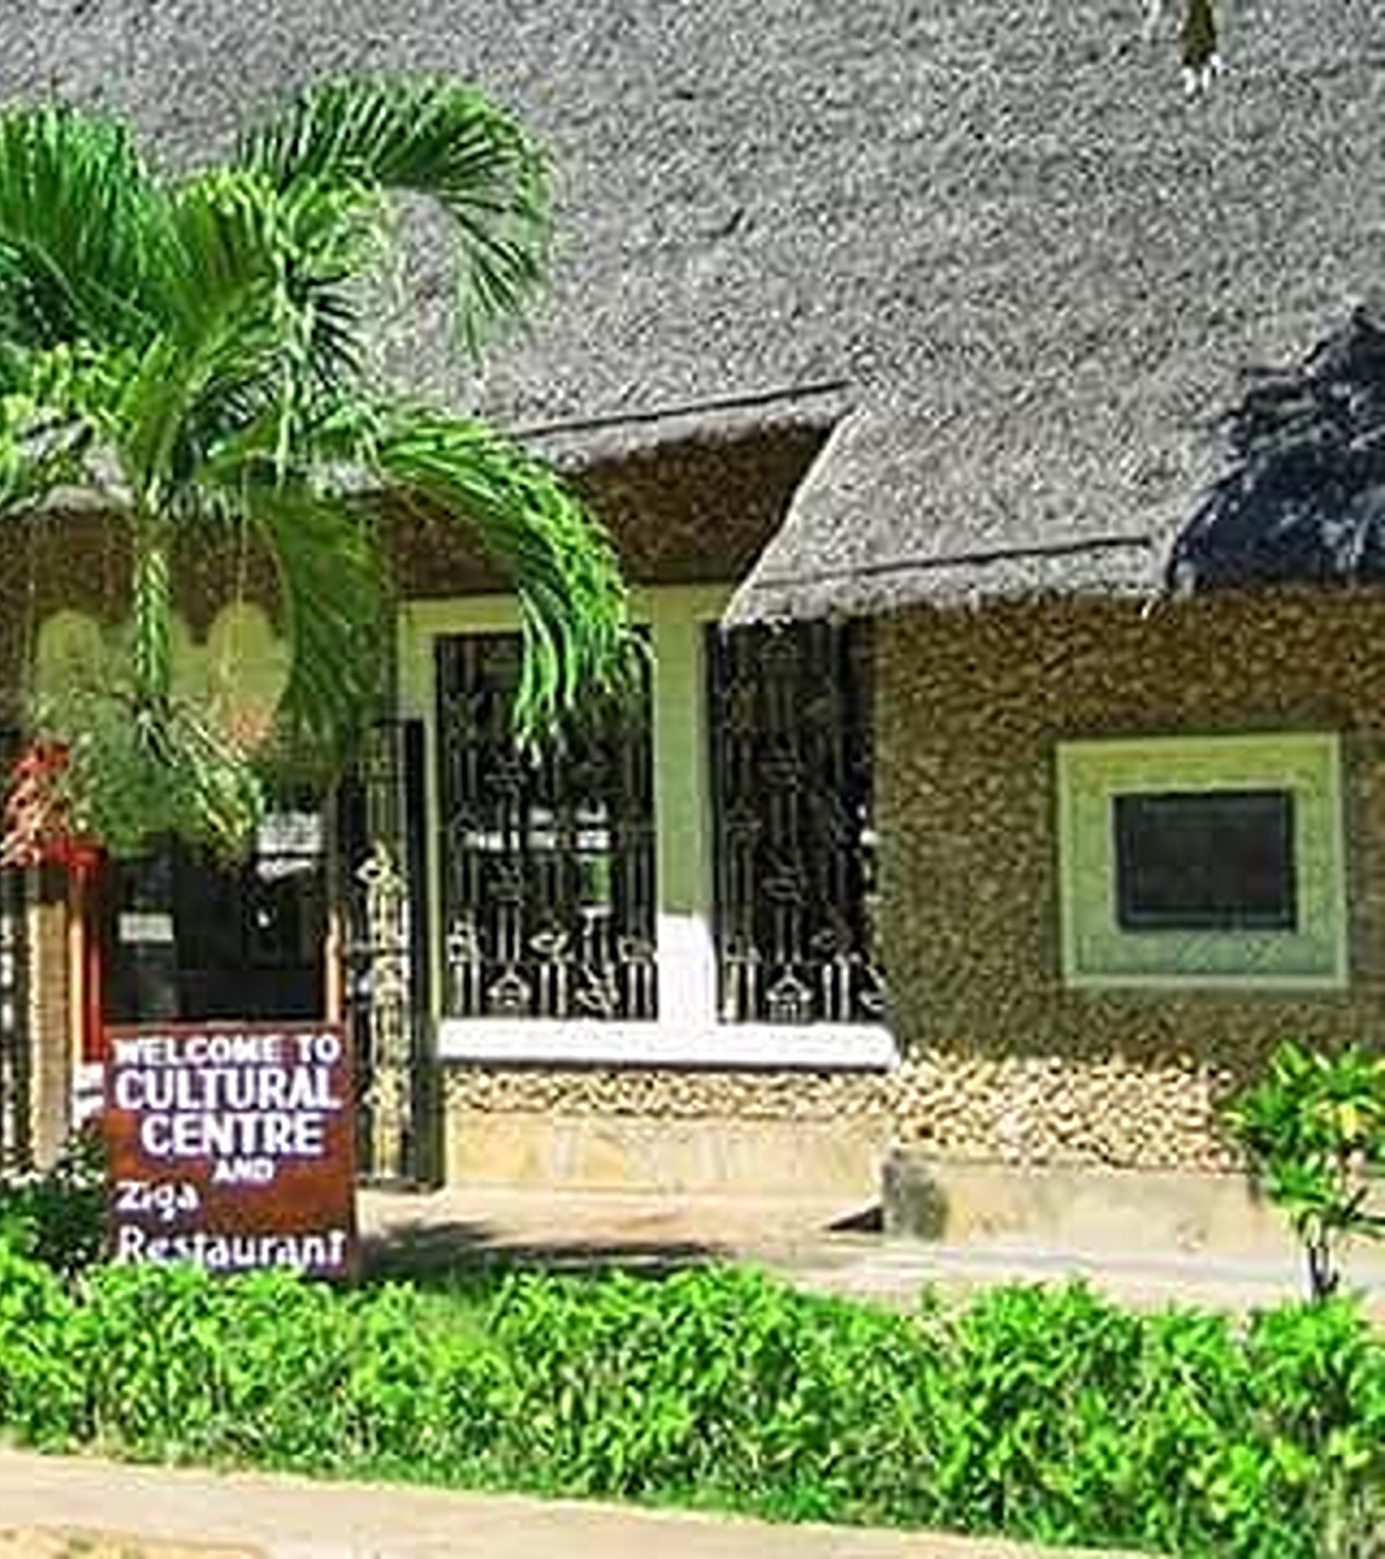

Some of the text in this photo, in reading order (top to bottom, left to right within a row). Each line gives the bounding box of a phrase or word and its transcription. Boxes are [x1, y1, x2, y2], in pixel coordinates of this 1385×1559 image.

[113, 1034, 340, 1065] WELCOME TO
[116, 1068, 341, 1109] CULTURAL
[142, 1113, 323, 1154] CENTRE
[213, 1158, 274, 1182] AND
[118, 1226, 346, 1268] Restaurant
